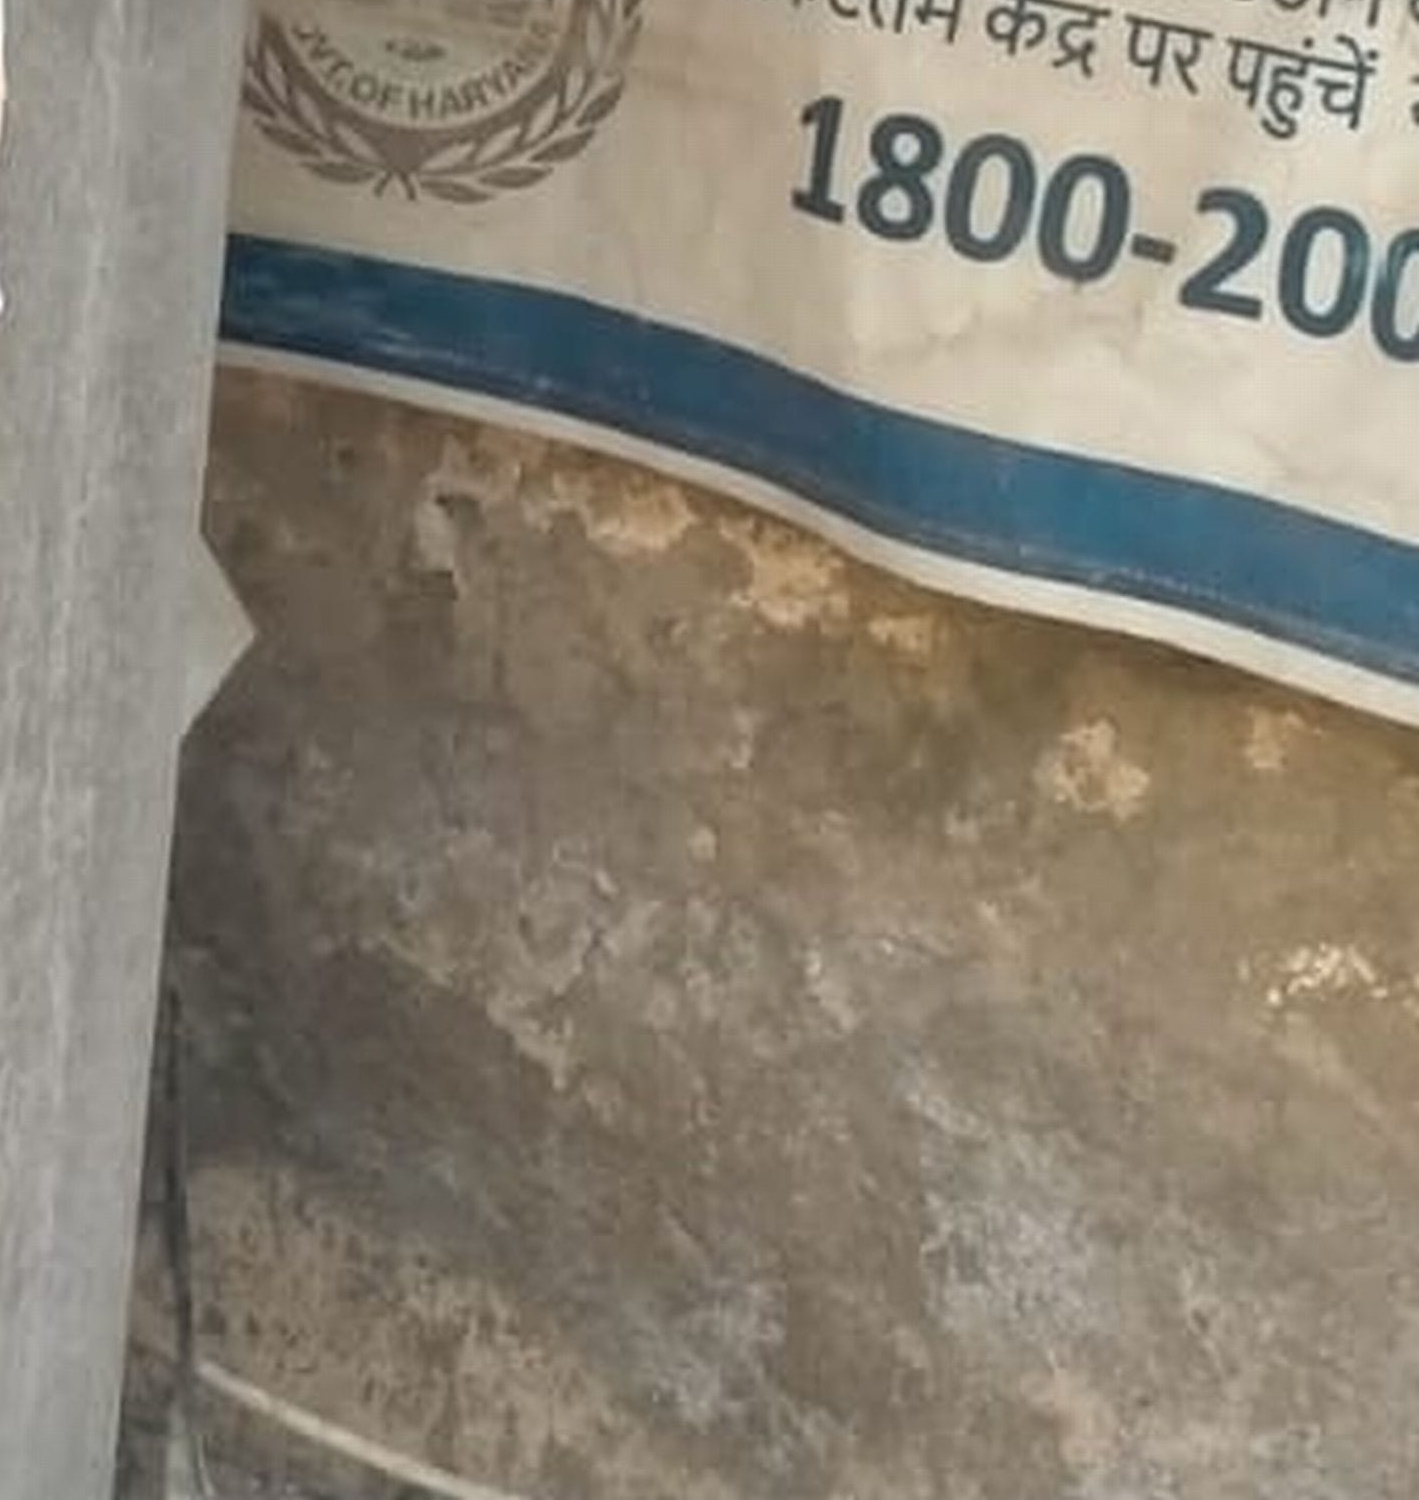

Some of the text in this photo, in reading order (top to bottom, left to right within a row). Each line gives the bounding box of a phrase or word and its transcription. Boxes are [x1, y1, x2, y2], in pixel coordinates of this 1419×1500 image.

[349, 72, 403, 109] OF
[1126, 13, 1213, 96] पर
[1227, 34, 1378, 140] पहुंचें
